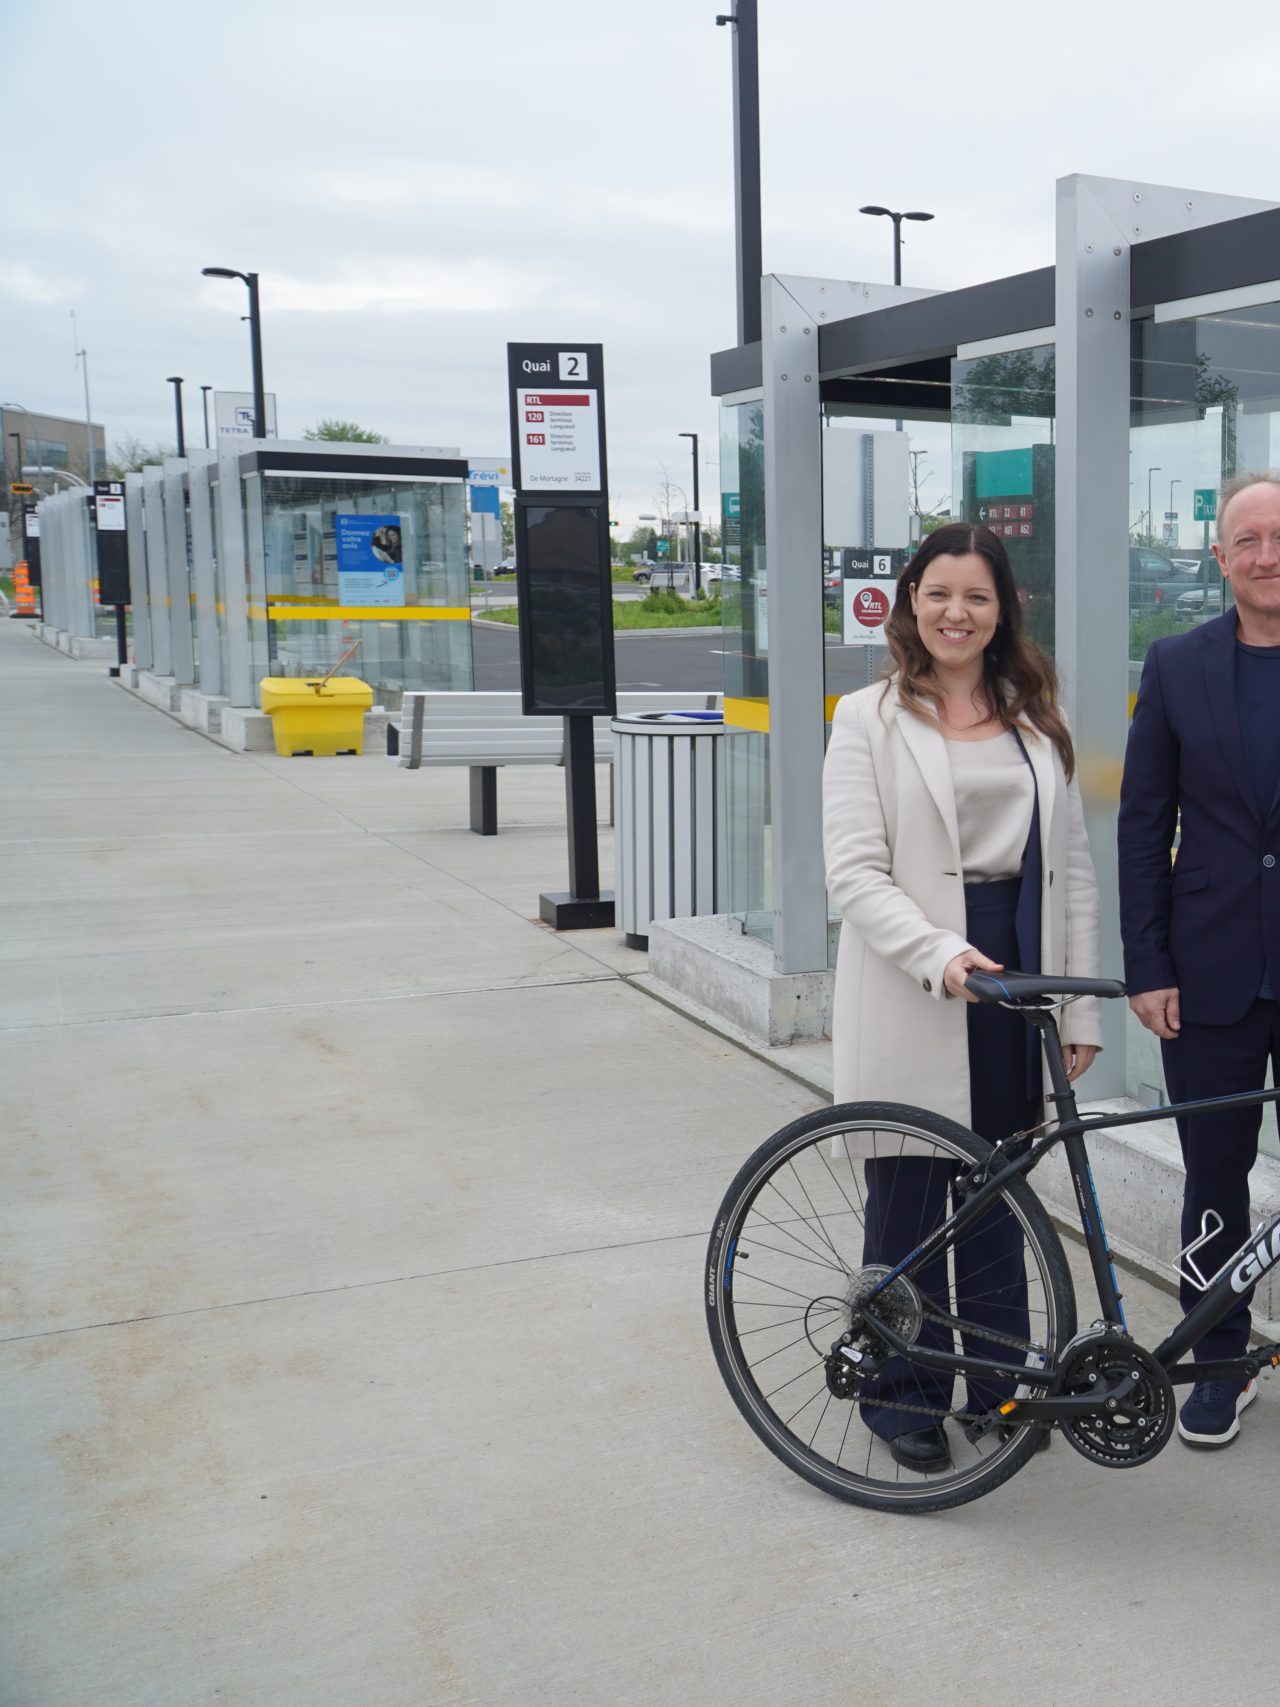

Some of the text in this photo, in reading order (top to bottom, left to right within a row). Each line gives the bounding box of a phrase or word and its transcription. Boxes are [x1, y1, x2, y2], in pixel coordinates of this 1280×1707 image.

[522, 357, 580, 376] Quai 2
[526, 396, 543, 405] RTL
[528, 412, 543, 421] 120
[529, 435, 544, 444] 161
[540, 475, 569, 483] Mortagne
[1195, 495, 1204, 515] P
[341, 529, 370, 537] Donnez
[851, 558, 886, 572] Quai 6
[708, 1265, 716, 1307] GIANT
